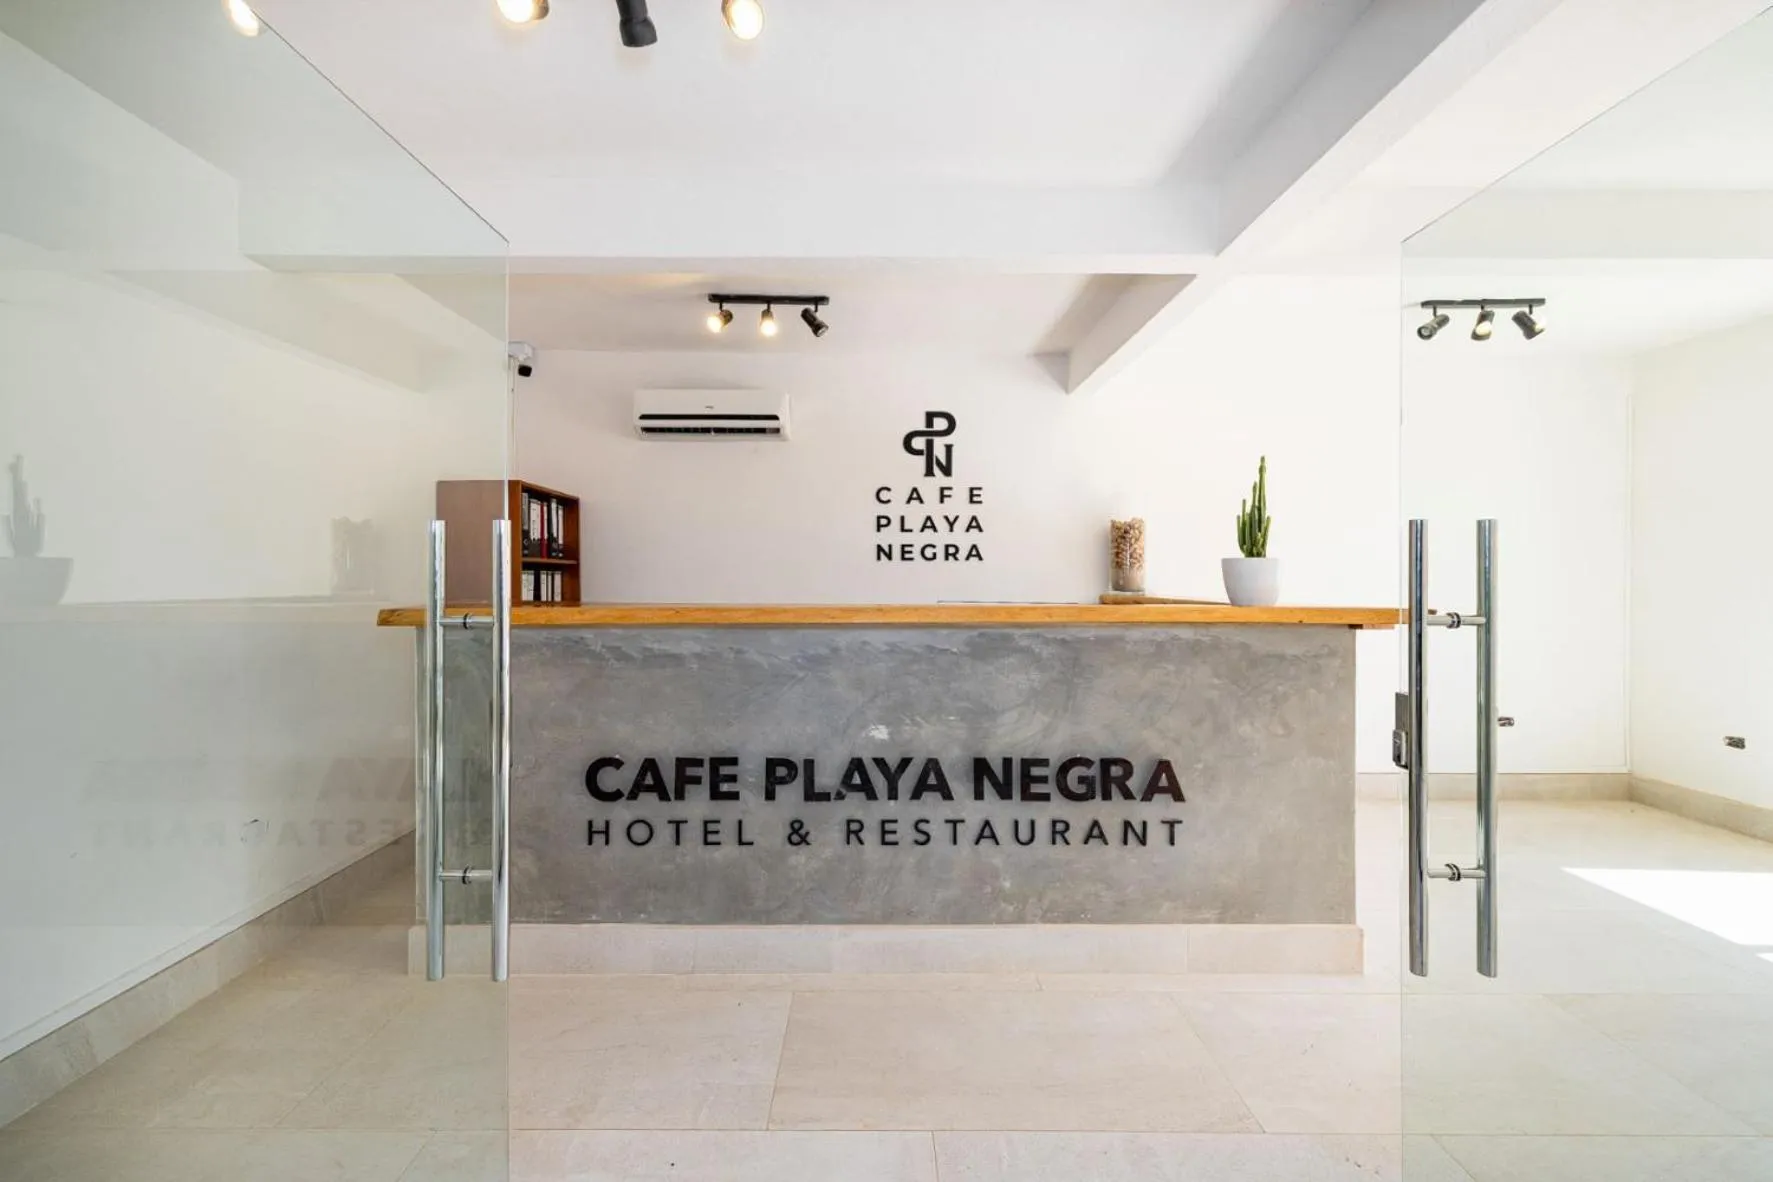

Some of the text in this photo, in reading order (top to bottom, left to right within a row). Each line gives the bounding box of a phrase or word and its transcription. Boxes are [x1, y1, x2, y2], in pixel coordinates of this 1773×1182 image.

[875, 486, 984, 505] CAFE
[876, 515, 984, 533] PLAYA
[876, 543, 984, 562] NEGRA
[585, 756, 1187, 803] CAFE PLAYA NEGRA
[586, 817, 1184, 847] HOTEL & RESTAURANT
